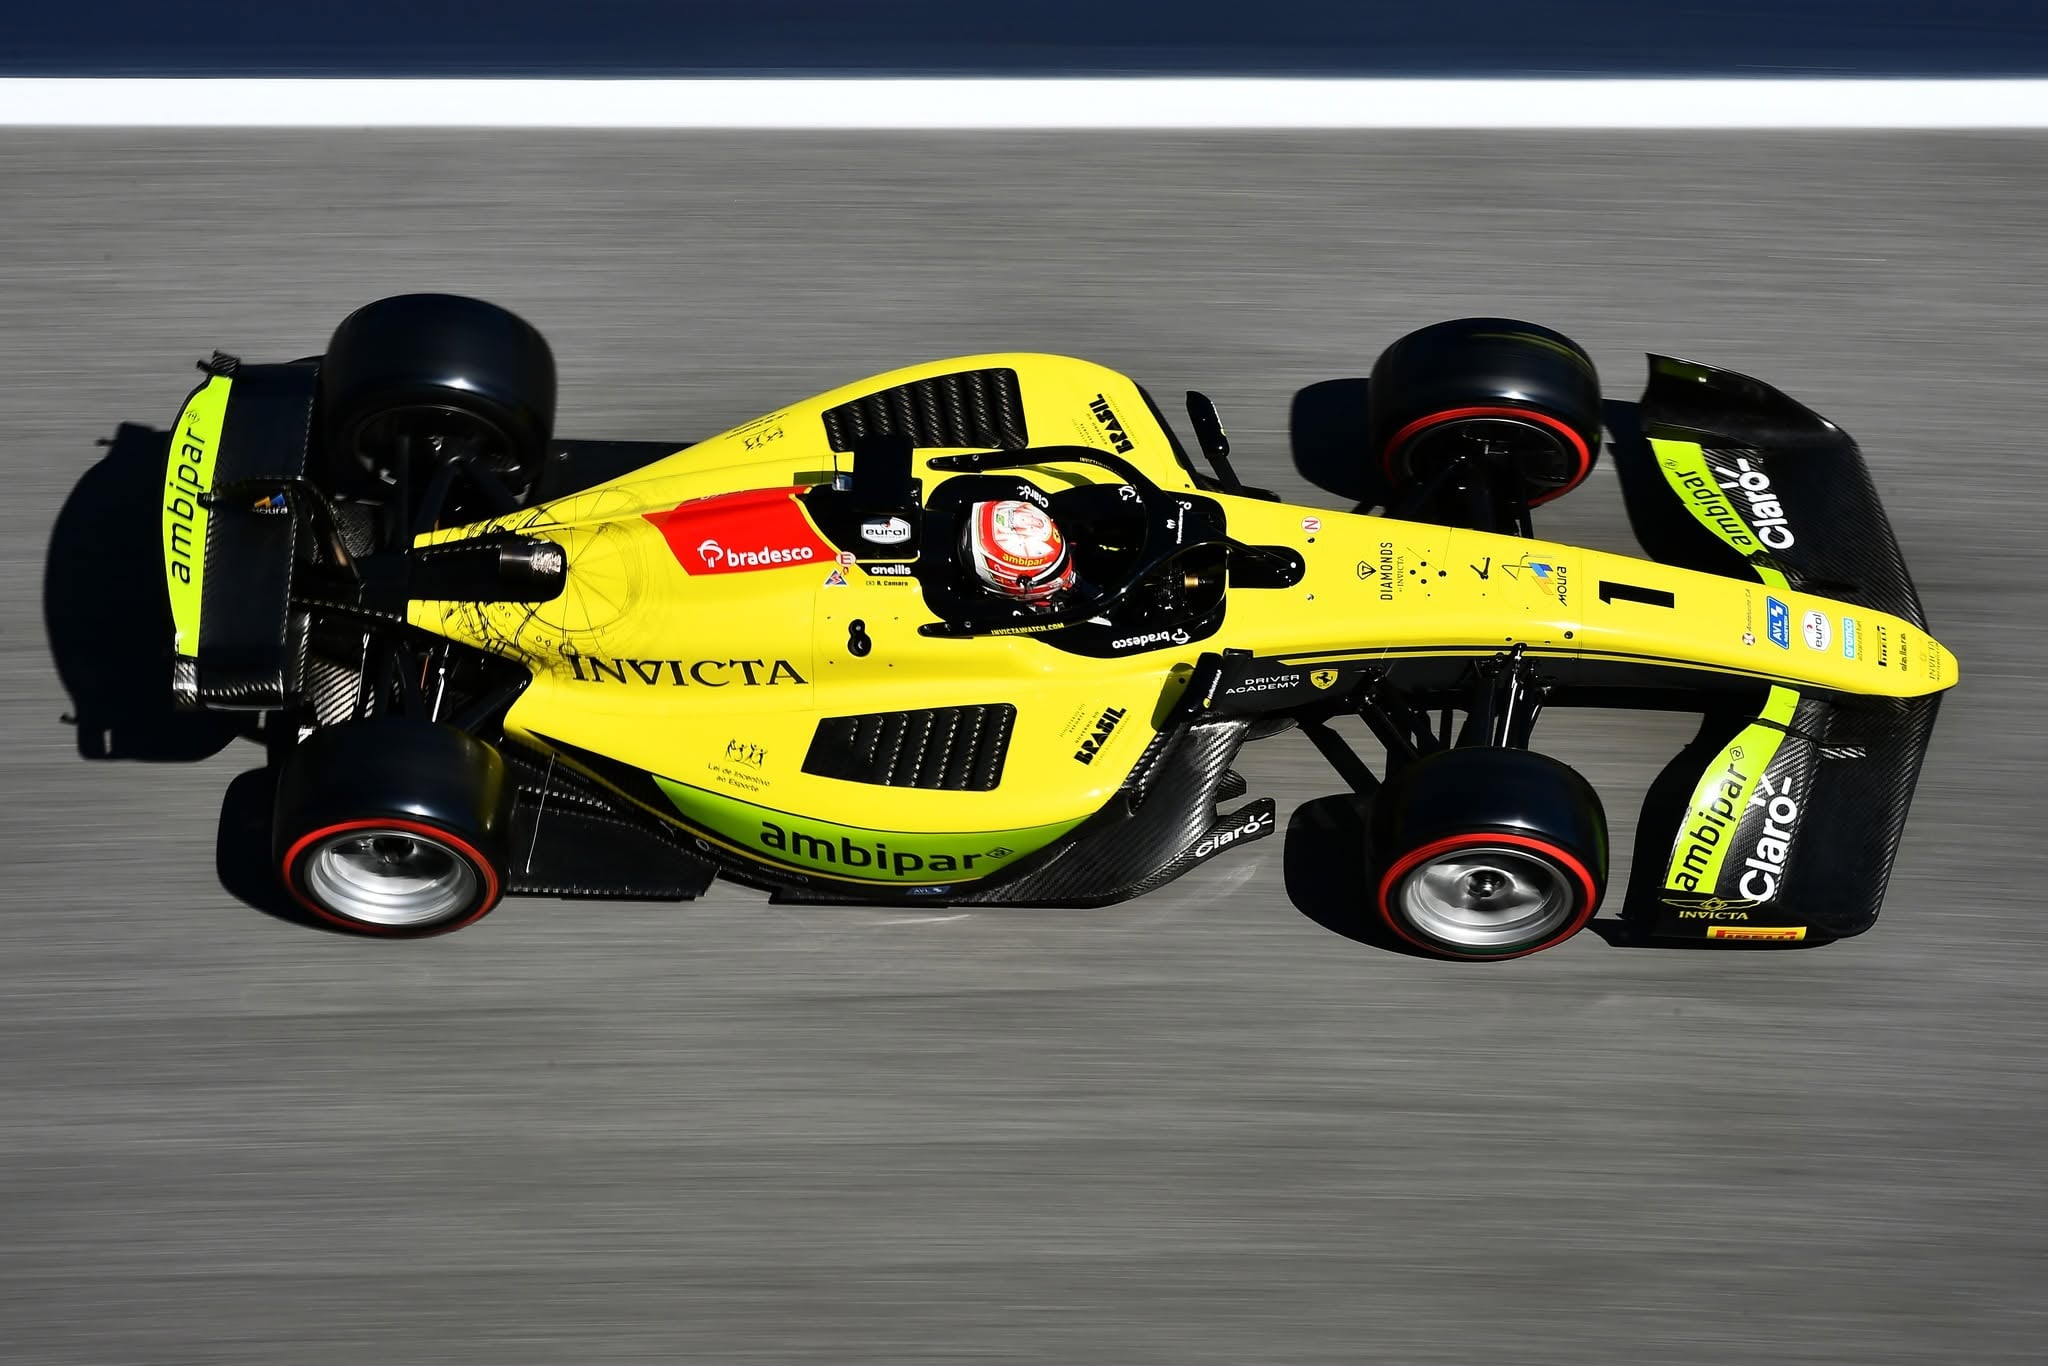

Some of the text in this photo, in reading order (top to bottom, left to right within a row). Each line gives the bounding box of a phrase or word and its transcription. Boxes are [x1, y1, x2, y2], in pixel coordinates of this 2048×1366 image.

[1089, 393, 1135, 454] BRASIL
[168, 427, 206, 584] ambipar
[1018, 485, 1049, 508] Claro
[1676, 470, 1752, 546] ambipar
[1735, 466, 1795, 550] Claro
[865, 528, 906, 536] eurol
[727, 546, 813, 568] bradesco
[1002, 553, 1044, 567] ambipar
[1380, 542, 1393, 601] DIAMONDS
[1599, 580, 1675, 609] 1
[1112, 631, 1170, 649] bradesco
[1772, 620, 1782, 641] AVL
[1814, 613, 1823, 648] eurol
[1845, 620, 1854, 657] aramco
[1899, 633, 1907, 672] dallara
[571, 655, 809, 687] INVICTA
[1225, 681, 1300, 695] ACADEMY
[1245, 674, 1300, 686] DRIVER
[1074, 707, 1127, 765] BRASIL
[1195, 815, 1267, 858] Claro
[1675, 764, 1748, 892] ambipar
[1739, 786, 1798, 900] Claro
[760, 820, 985, 876] ambipar
[1678, 910, 1749, 920] INVICTA
